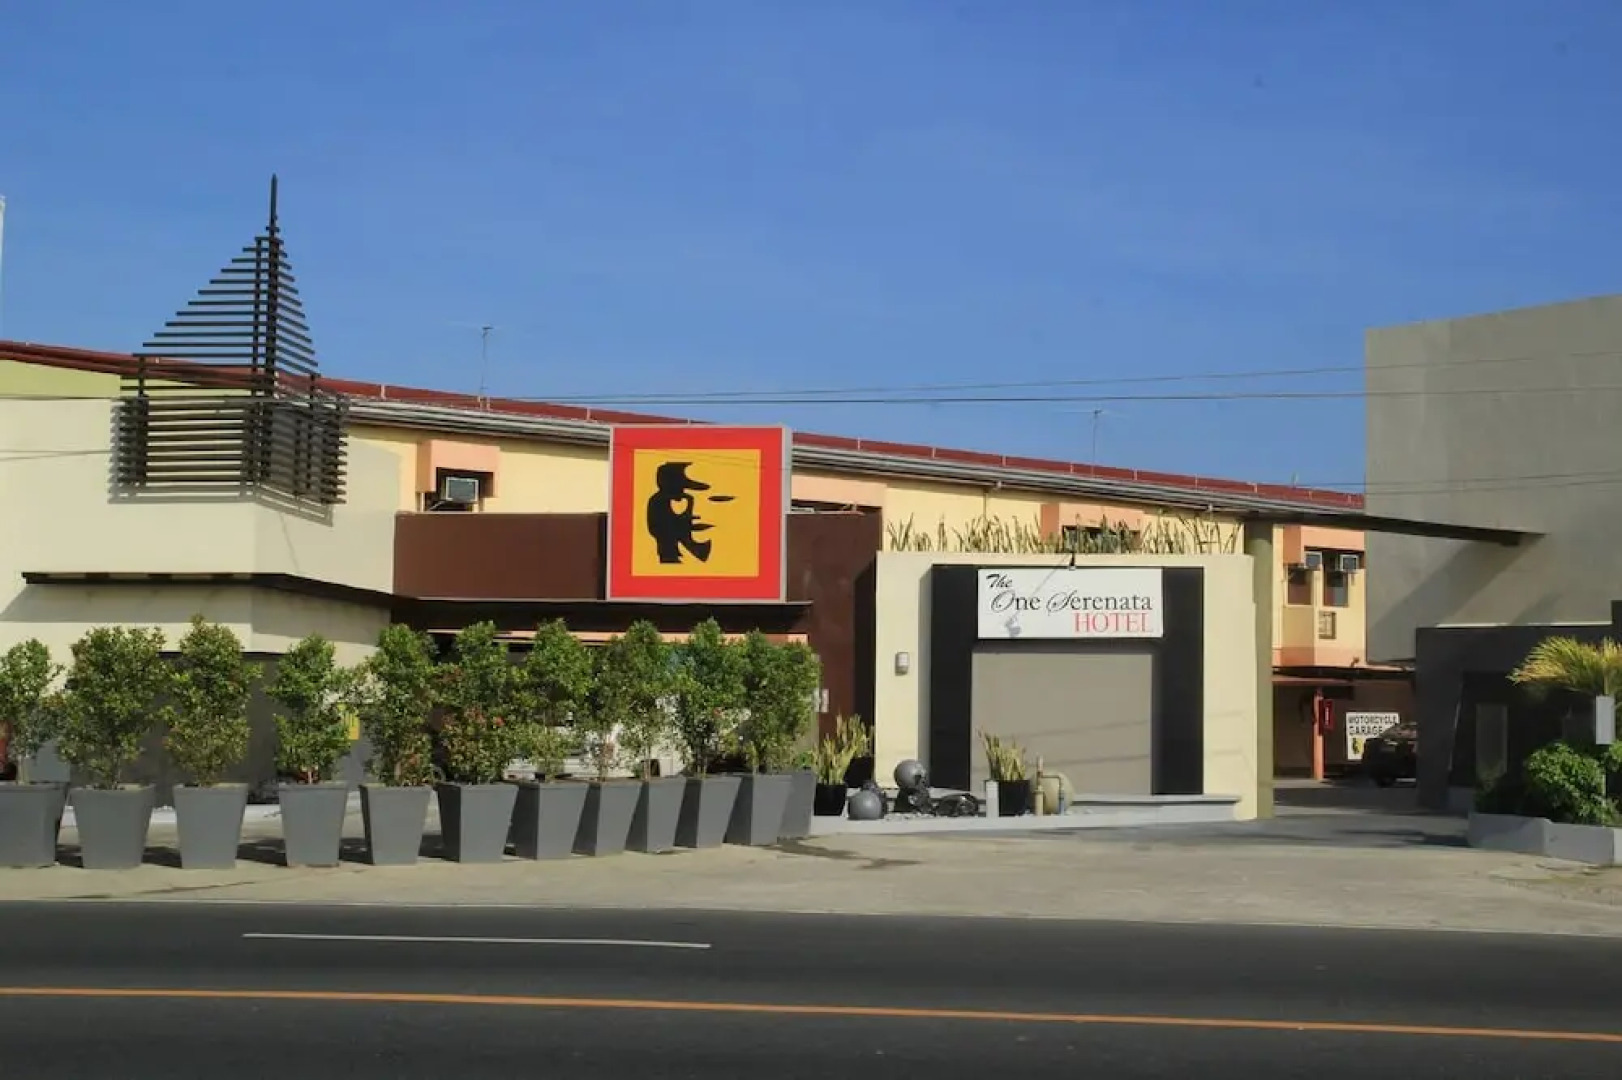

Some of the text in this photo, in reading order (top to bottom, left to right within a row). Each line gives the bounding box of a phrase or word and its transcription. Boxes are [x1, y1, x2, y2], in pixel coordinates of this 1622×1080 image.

[986, 573, 1013, 588] The
[990, 590, 1152, 615] One Serenata
[1074, 612, 1153, 633] HOTEL
[1348, 715, 1397, 724] MOTORCYCLE
[1349, 725, 1383, 736] GARAGE
